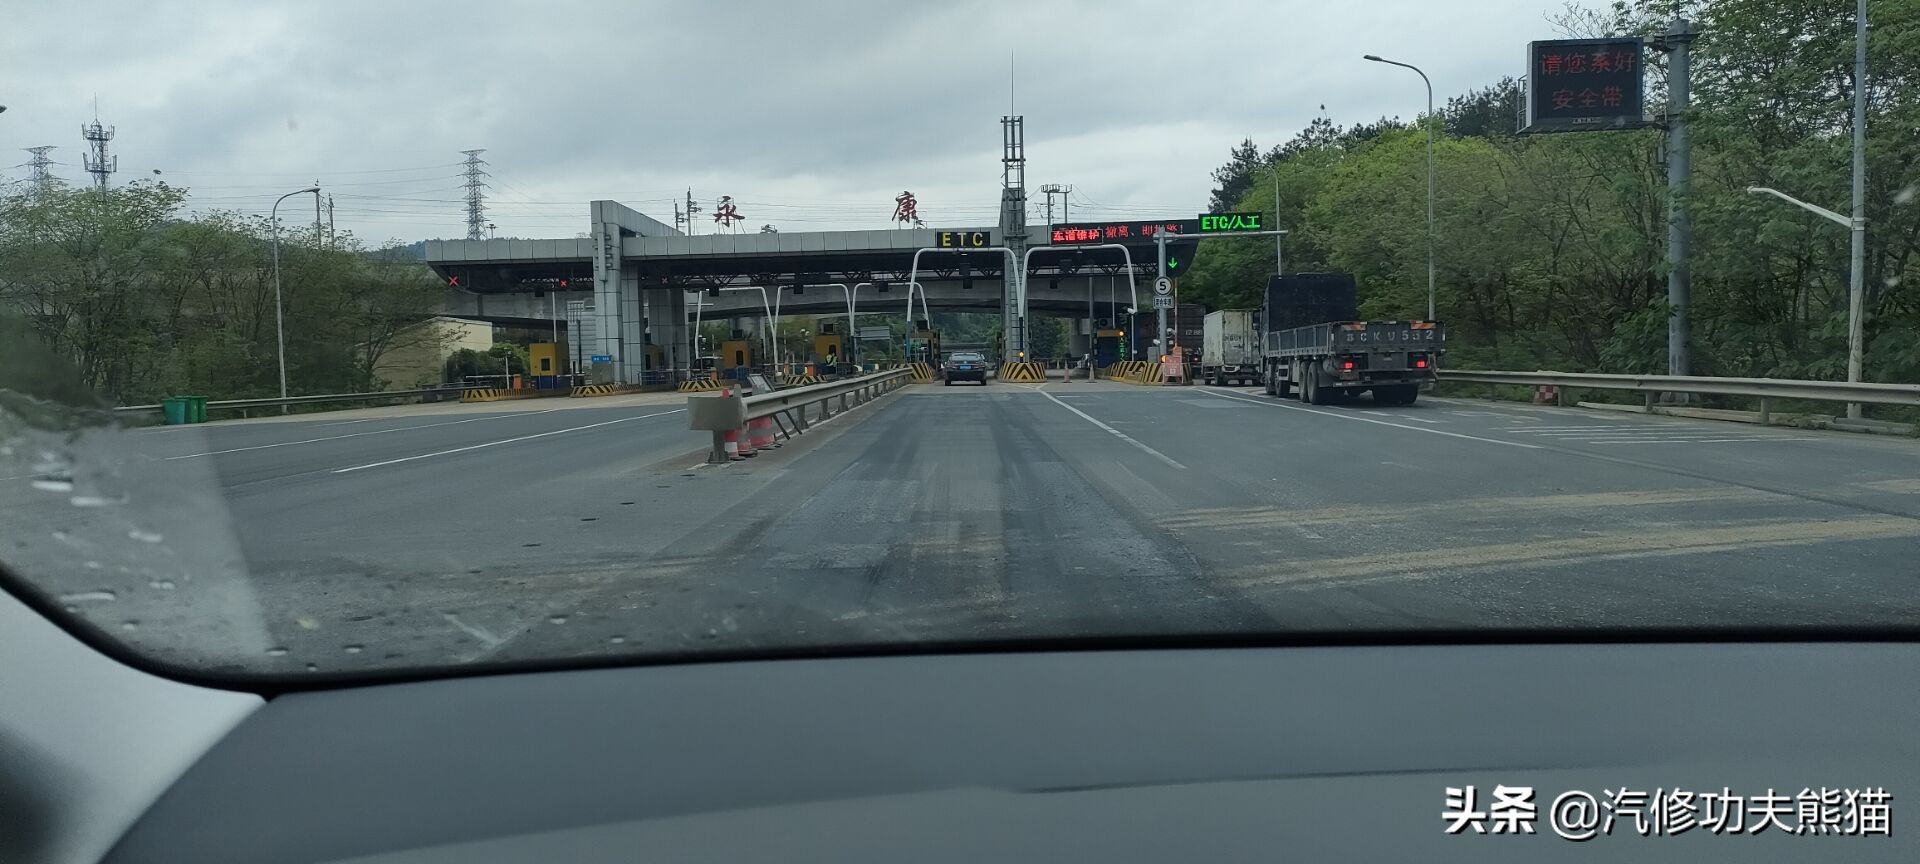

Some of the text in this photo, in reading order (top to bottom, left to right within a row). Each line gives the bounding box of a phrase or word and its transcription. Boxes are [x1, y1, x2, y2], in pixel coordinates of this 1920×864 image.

[1541, 51, 1636, 76] 请您系好
[1552, 86, 1623, 110] 安全带
[713, 190, 918, 228] 永 康
[1201, 215, 1261, 230] ETC/人工
[942, 232, 983, 247] ETC
[1053, 229, 1100, 241] 车道维护
[1159, 281, 1167, 291] 5
